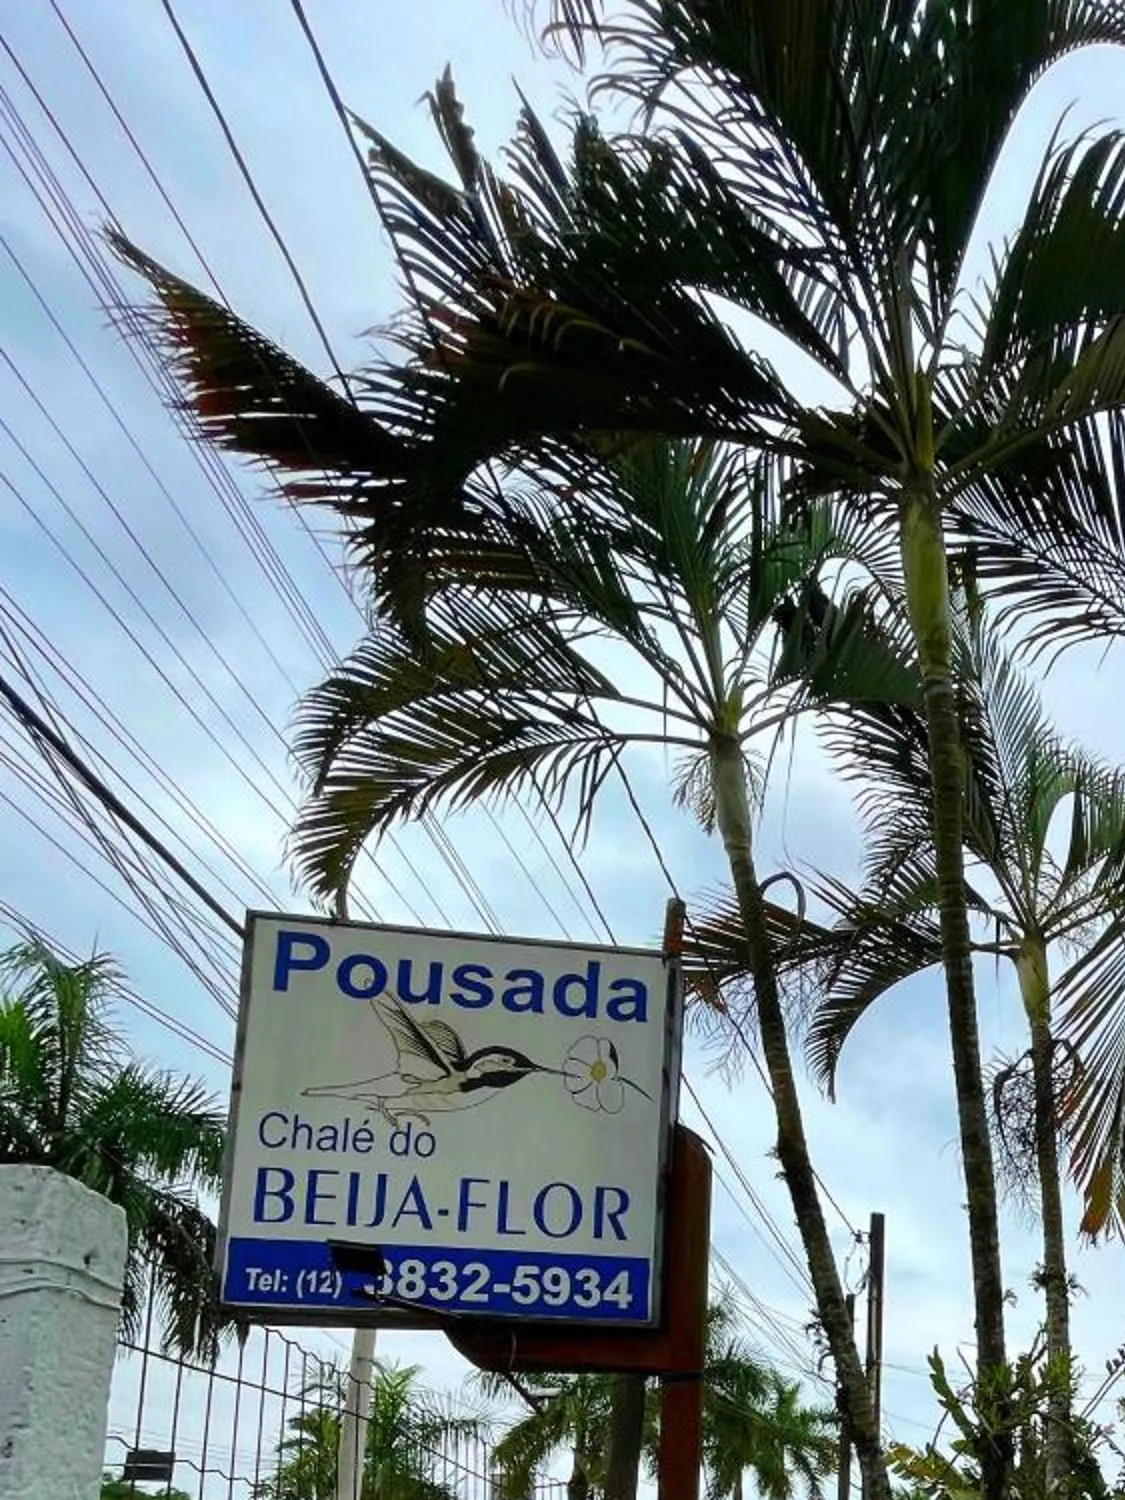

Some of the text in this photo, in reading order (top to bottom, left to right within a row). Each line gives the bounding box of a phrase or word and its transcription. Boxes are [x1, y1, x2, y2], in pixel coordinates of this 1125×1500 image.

[273, 931, 648, 1022] Pousada
[259, 1111, 437, 1159] Chalé do
[253, 1167, 631, 1241] BEIJA-FLOR
[245, 1267, 289, 1293] Tel:
[296, 1270, 343, 1299] (12)
